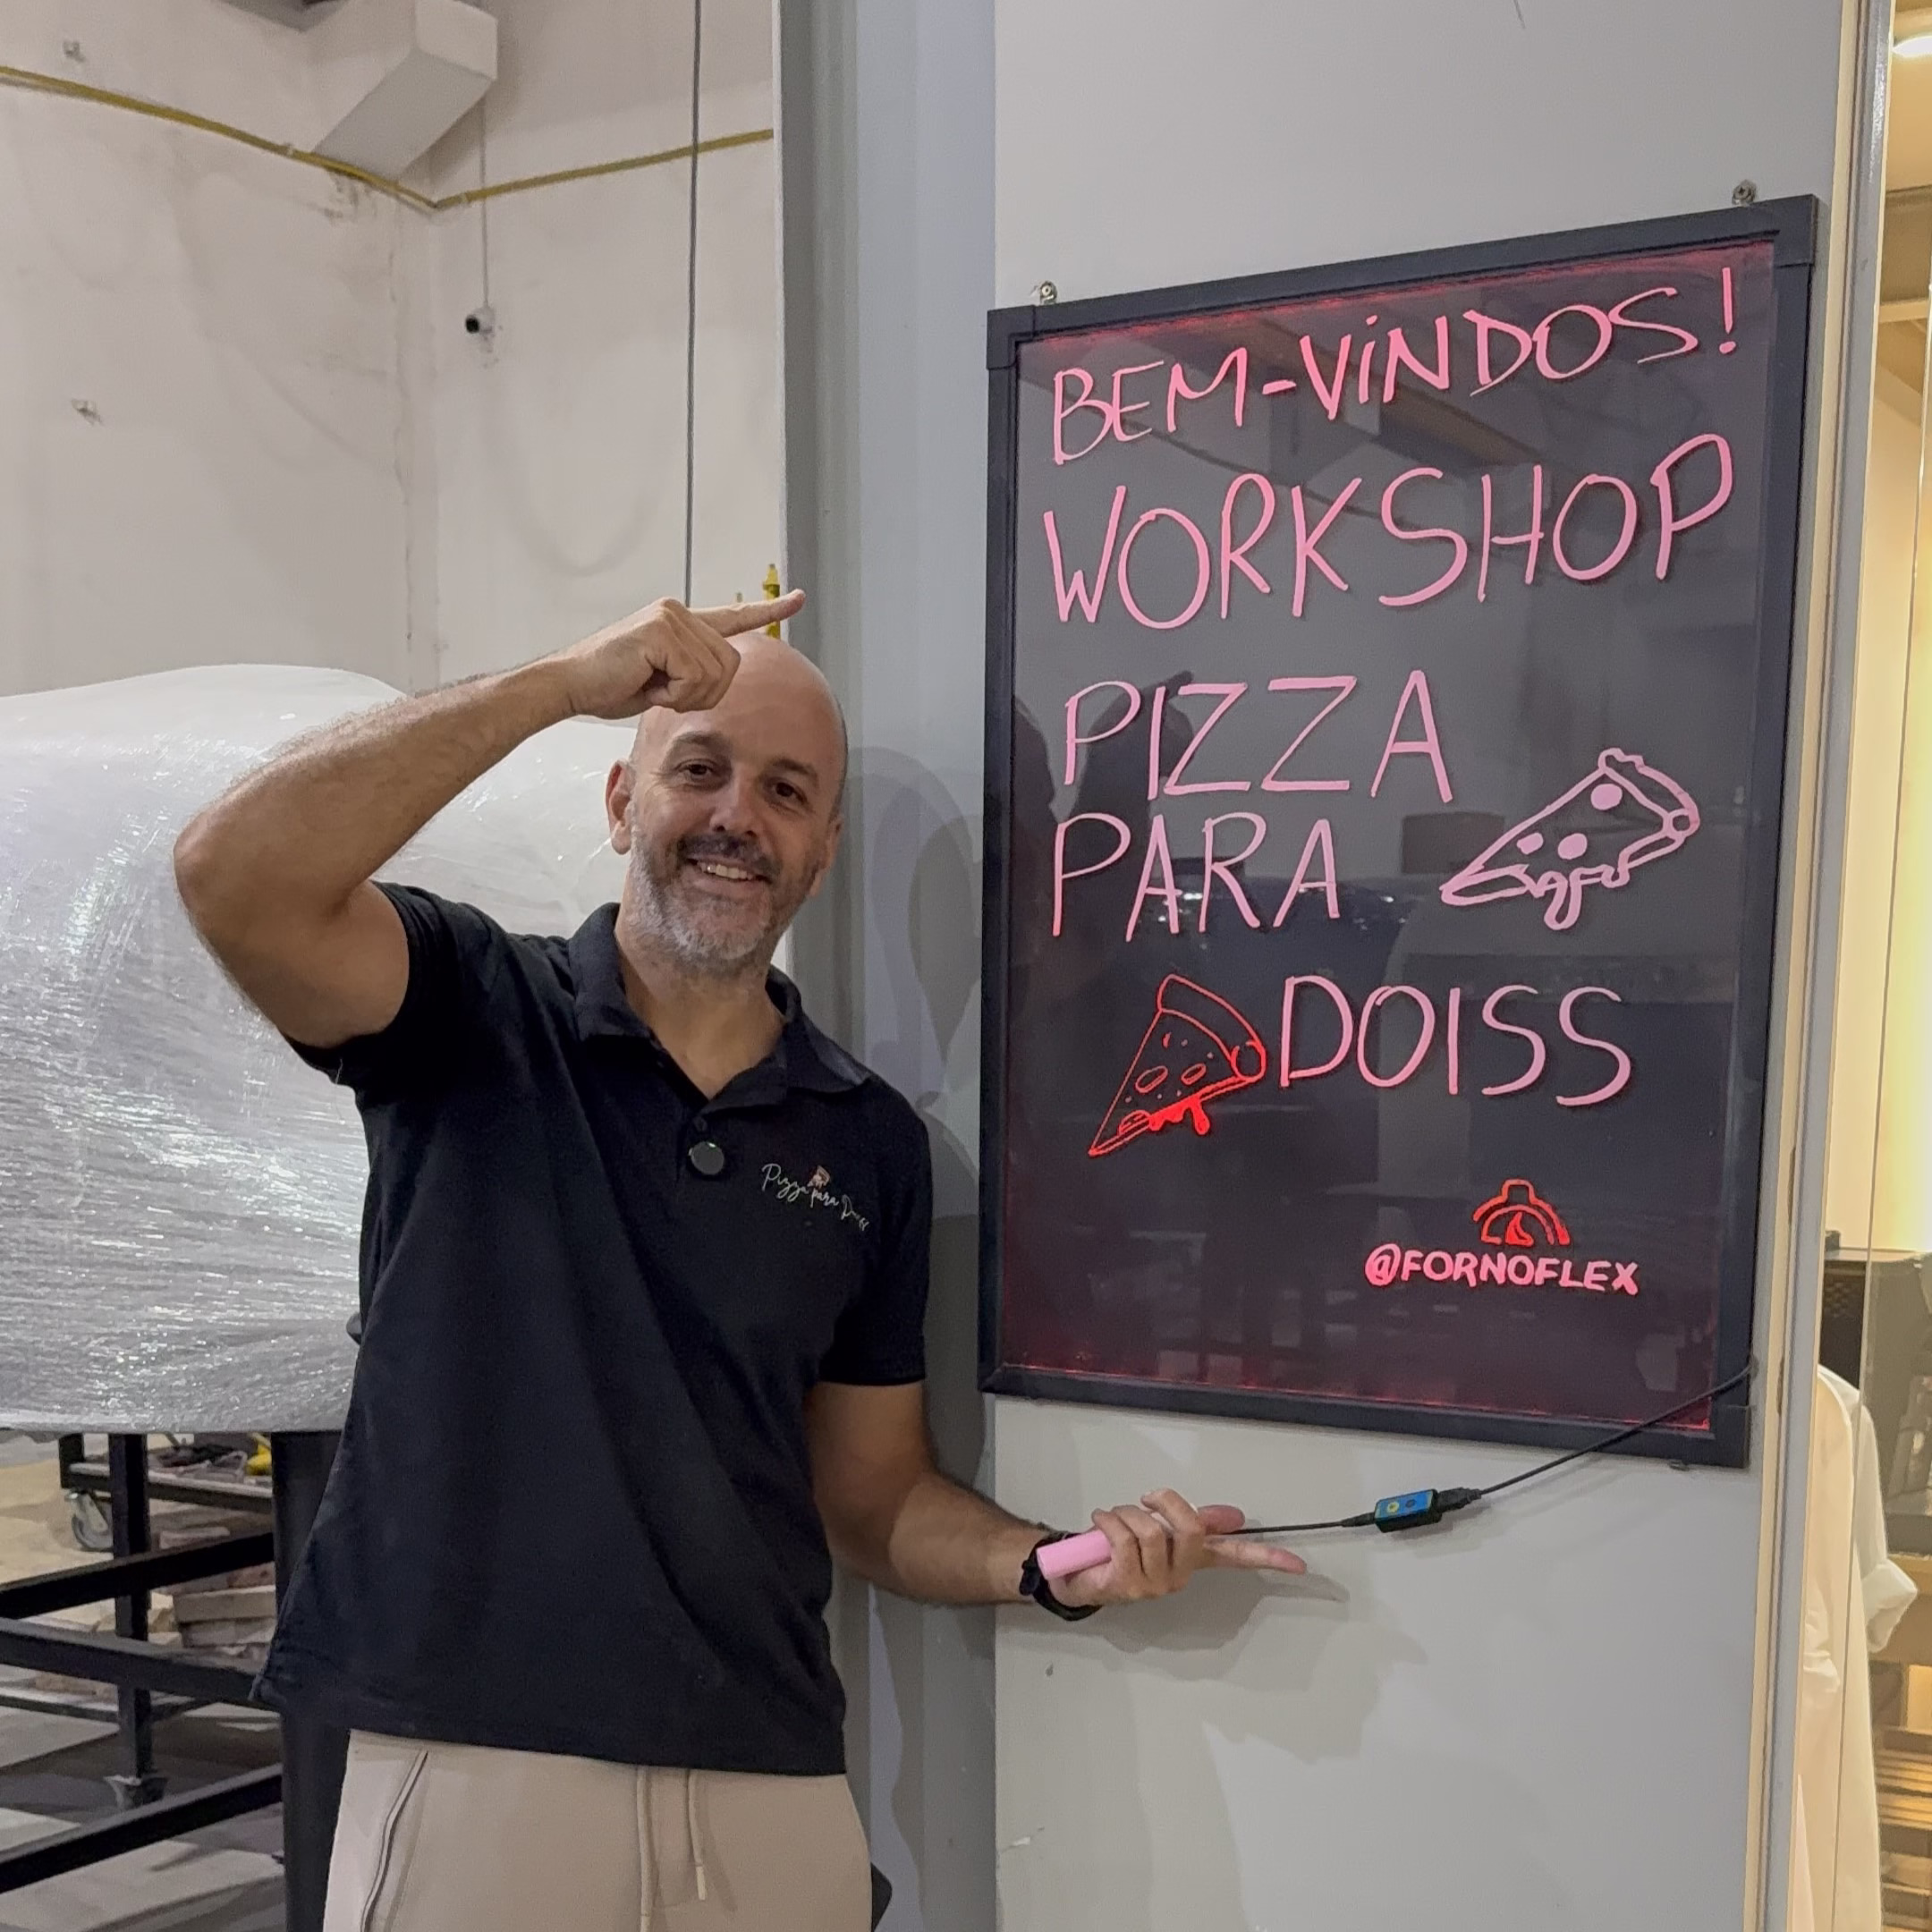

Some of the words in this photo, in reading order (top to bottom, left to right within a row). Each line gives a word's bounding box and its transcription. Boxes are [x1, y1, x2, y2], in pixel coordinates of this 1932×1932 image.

[1043, 433, 1735, 630] WORKSHOP
[1063, 669, 1453, 804] PIZZA
[1052, 811, 1342, 944] PARA
[1279, 975, 1633, 1108] DOISS
[761, 1163, 809, 1202] Pizza
[1364, 1243, 1639, 1296] @FORNOFLEX
